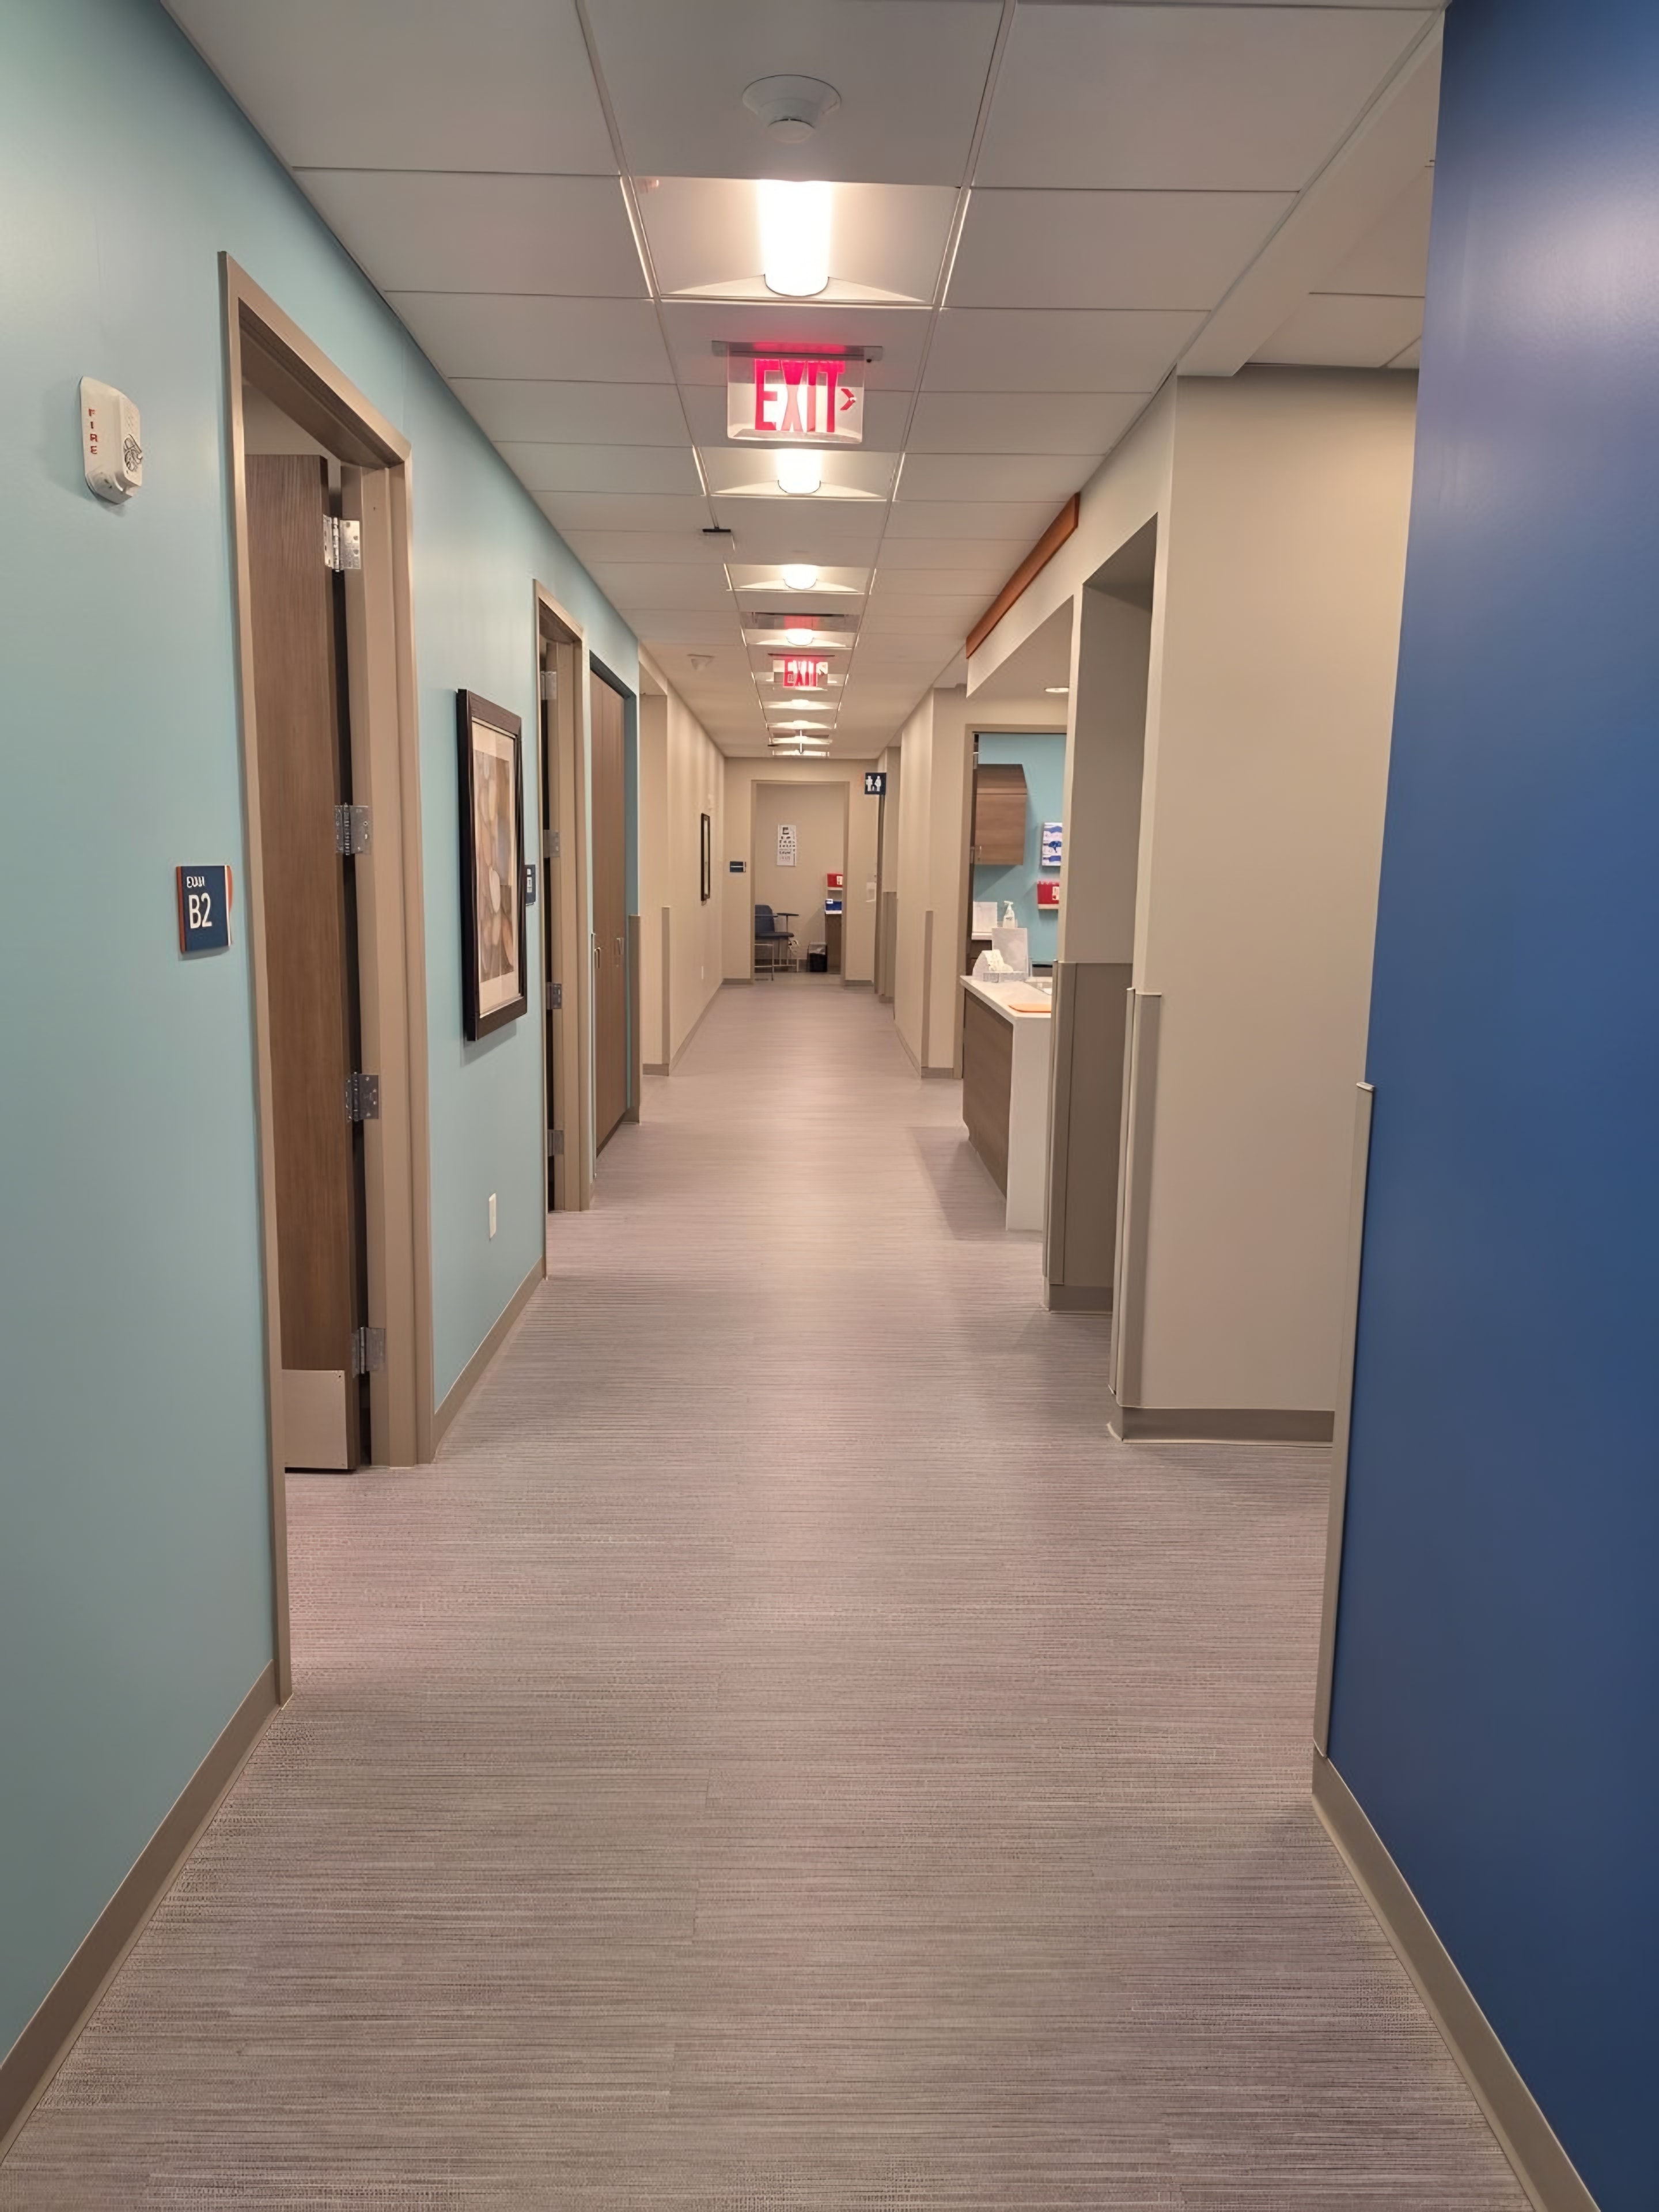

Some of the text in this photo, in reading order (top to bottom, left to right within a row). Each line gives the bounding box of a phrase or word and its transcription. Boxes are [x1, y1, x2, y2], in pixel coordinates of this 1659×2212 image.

[755, 358, 845, 433] EXIT
[88, 408, 98, 454] FIRE
[783, 659, 820, 687] EXIT
[188, 892, 213, 929] B2
